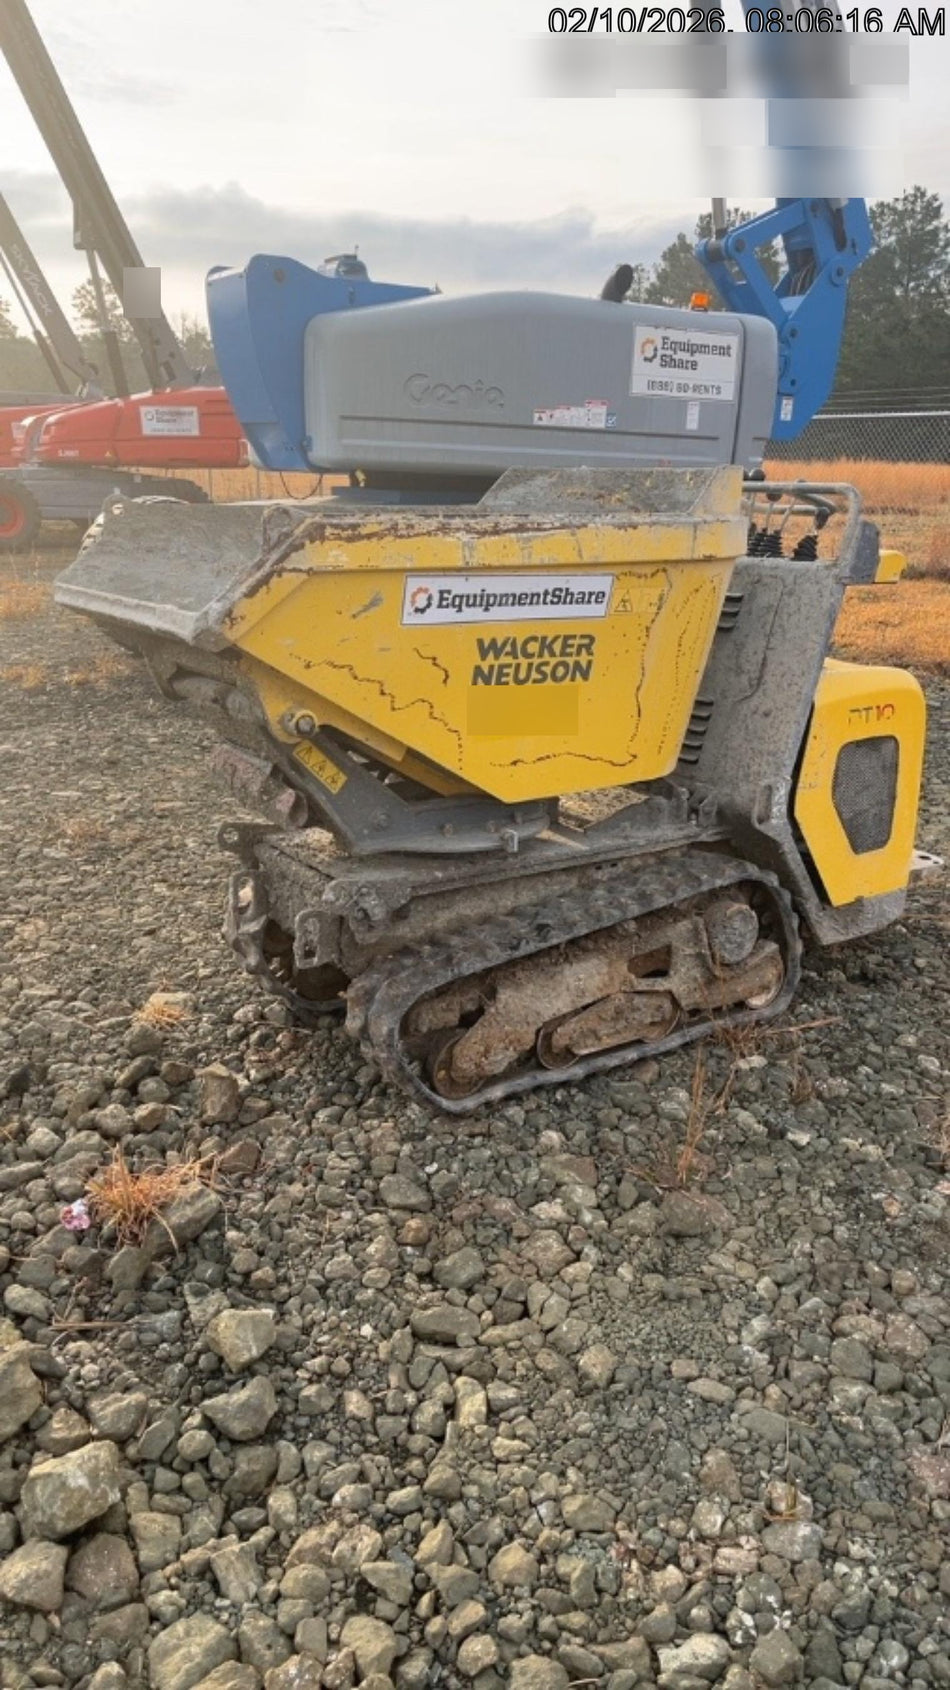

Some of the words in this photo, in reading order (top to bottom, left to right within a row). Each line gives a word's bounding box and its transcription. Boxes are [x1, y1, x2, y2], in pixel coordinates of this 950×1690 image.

[661, 335, 732, 357] Equipment
[659, 354, 698, 371] Share
[436, 586, 606, 613] EquipmentShare
[476, 634, 596, 662] WACKER
[471, 659, 594, 686] NEUSON
